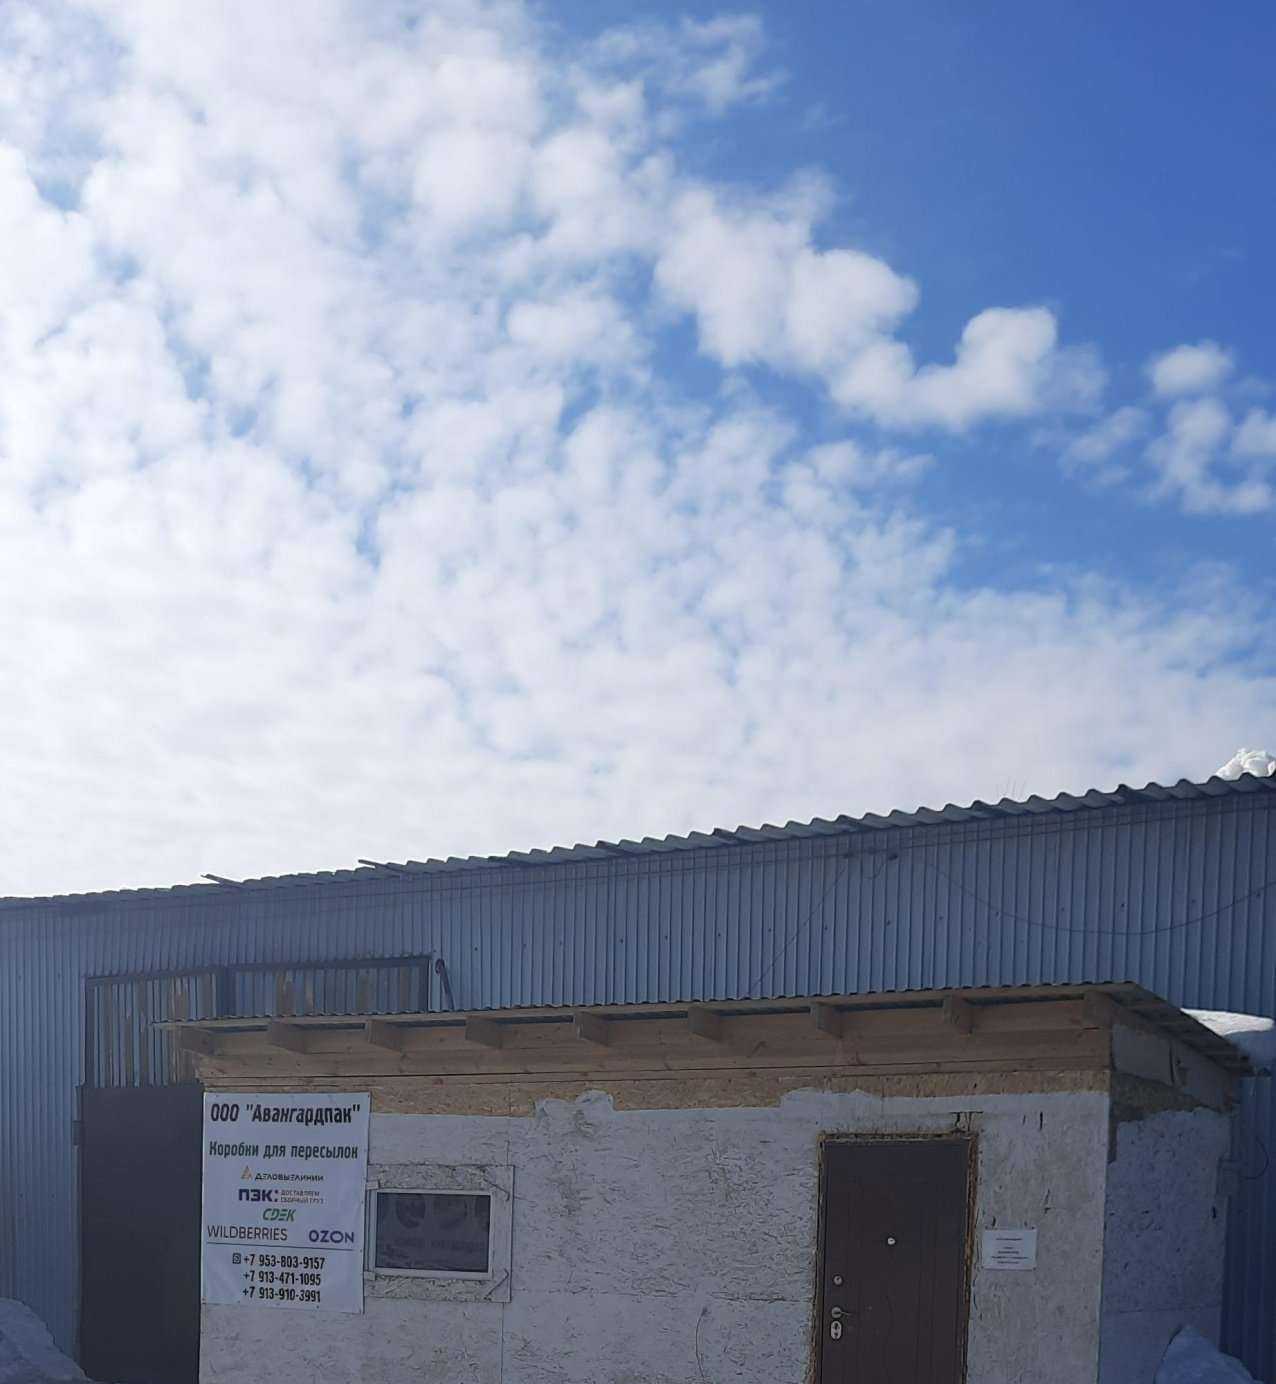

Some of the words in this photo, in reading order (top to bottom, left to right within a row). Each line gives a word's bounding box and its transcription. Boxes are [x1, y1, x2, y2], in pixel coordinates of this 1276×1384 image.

[210, 1103, 240, 1122] ООО
[246, 1103, 361, 1126] "Авангардпак"
[209, 1141, 259, 1159] Коробки
[263, 1145, 286, 1160] для
[290, 1146, 358, 1161] пересылок
[262, 1207, 297, 1222] CDEK
[207, 1224, 288, 1241] WILDBERRIES
[308, 1229, 355, 1244] OZON
[243, 1253, 255, 1266] +7
[259, 1254, 326, 1270] 953-803-9157
[243, 1270, 255, 1282] +7
[258, 1270, 321, 1286] 913-471-1095
[242, 1286, 256, 1299] +7
[258, 1286, 321, 1303] 913-910-3991
